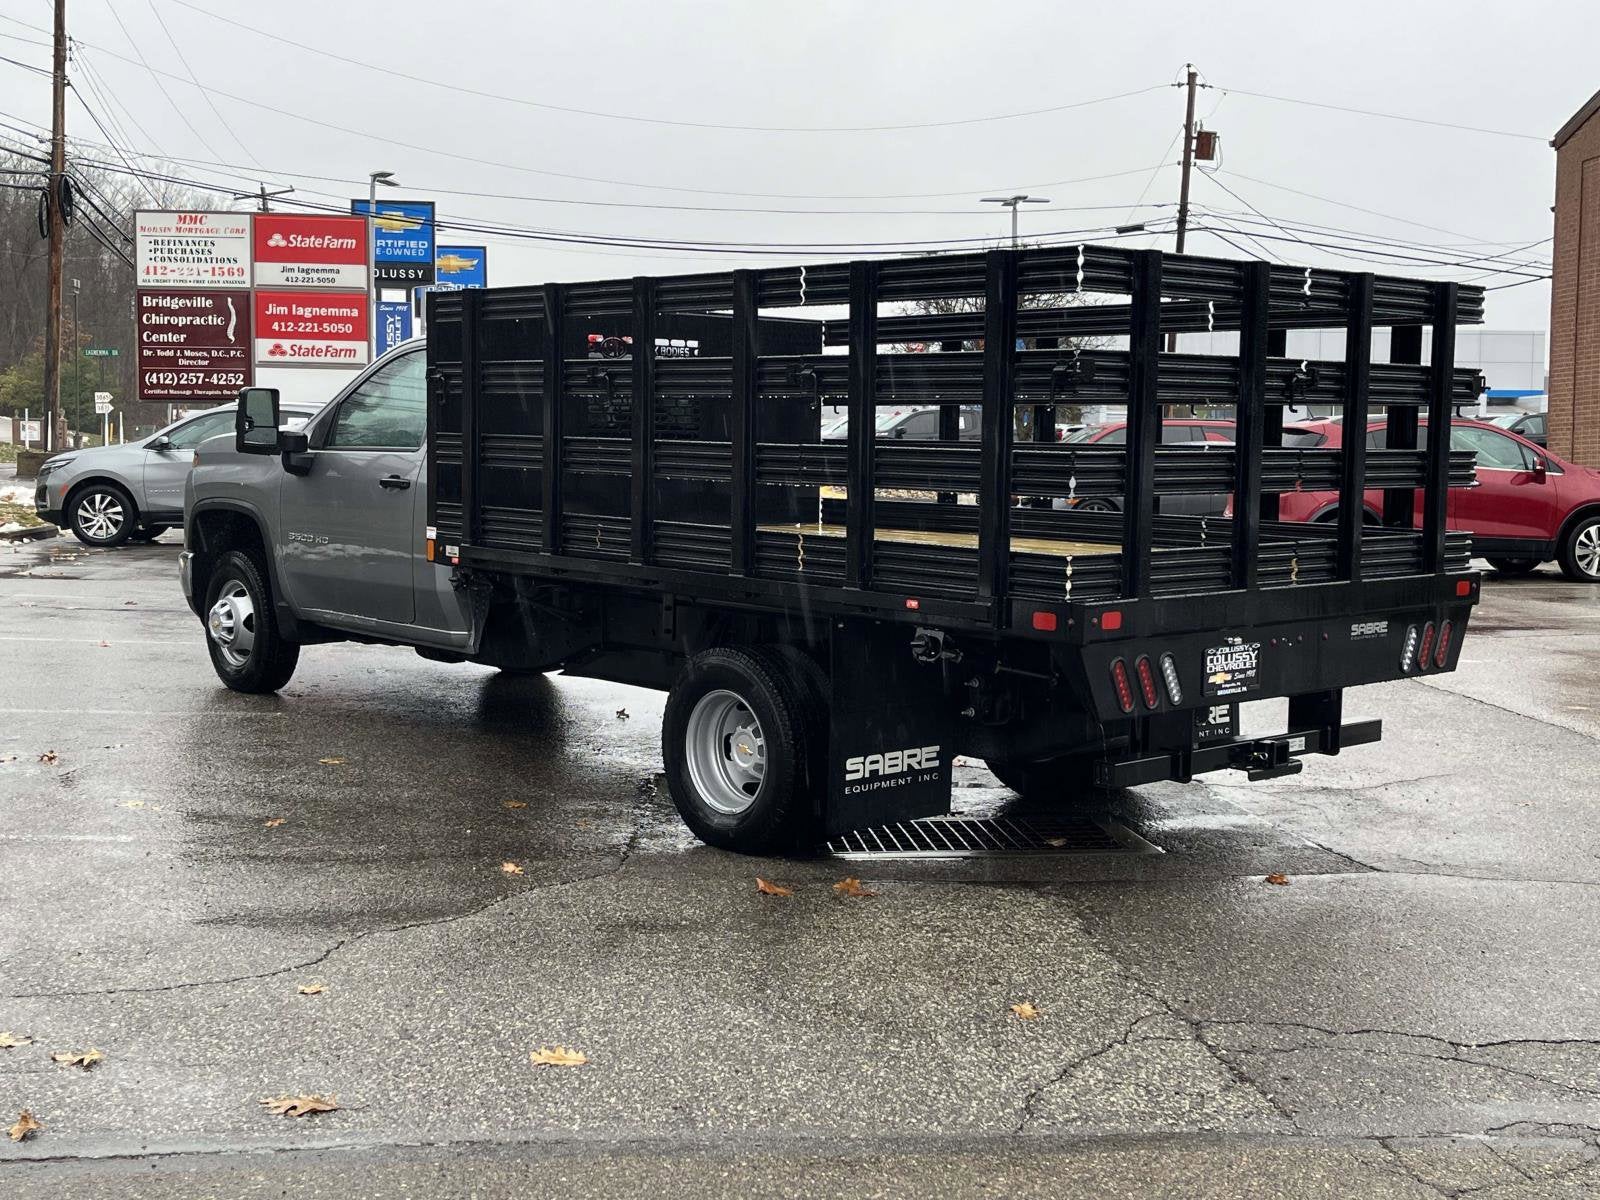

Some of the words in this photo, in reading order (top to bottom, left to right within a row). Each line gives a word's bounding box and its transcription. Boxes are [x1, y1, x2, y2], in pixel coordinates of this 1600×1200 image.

[176, 215, 207, 225] MMC
[376, 239, 429, 248] RTIFIED
[376, 248, 425, 256] E-OWNED
[153, 256, 238, 265] CONSOLIDATIONS
[144, 265, 245, 277] 412-221-1569
[373, 268, 424, 279] OLUSSY
[284, 276, 336, 284] 412-221-5050
[142, 296, 214, 310] Bridgeville
[265, 304, 288, 315] Jim
[292, 304, 359, 318] Iagnemma
[142, 313, 225, 327] Chiropractic
[272, 321, 353, 333] 412-221-5050
[142, 331, 187, 343] Center
[184, 350, 209, 358] Moses,
[661, 346, 690, 357] BODIES
[1351, 621, 1388, 636] SABRE
[1206, 650, 1258, 666] COLUSSY
[1206, 660, 1257, 673] CHEVROLET
[845, 745, 940, 781] SABRE
[844, 777, 912, 795] EQUIPMENT
[918, 773, 939, 782] INC
